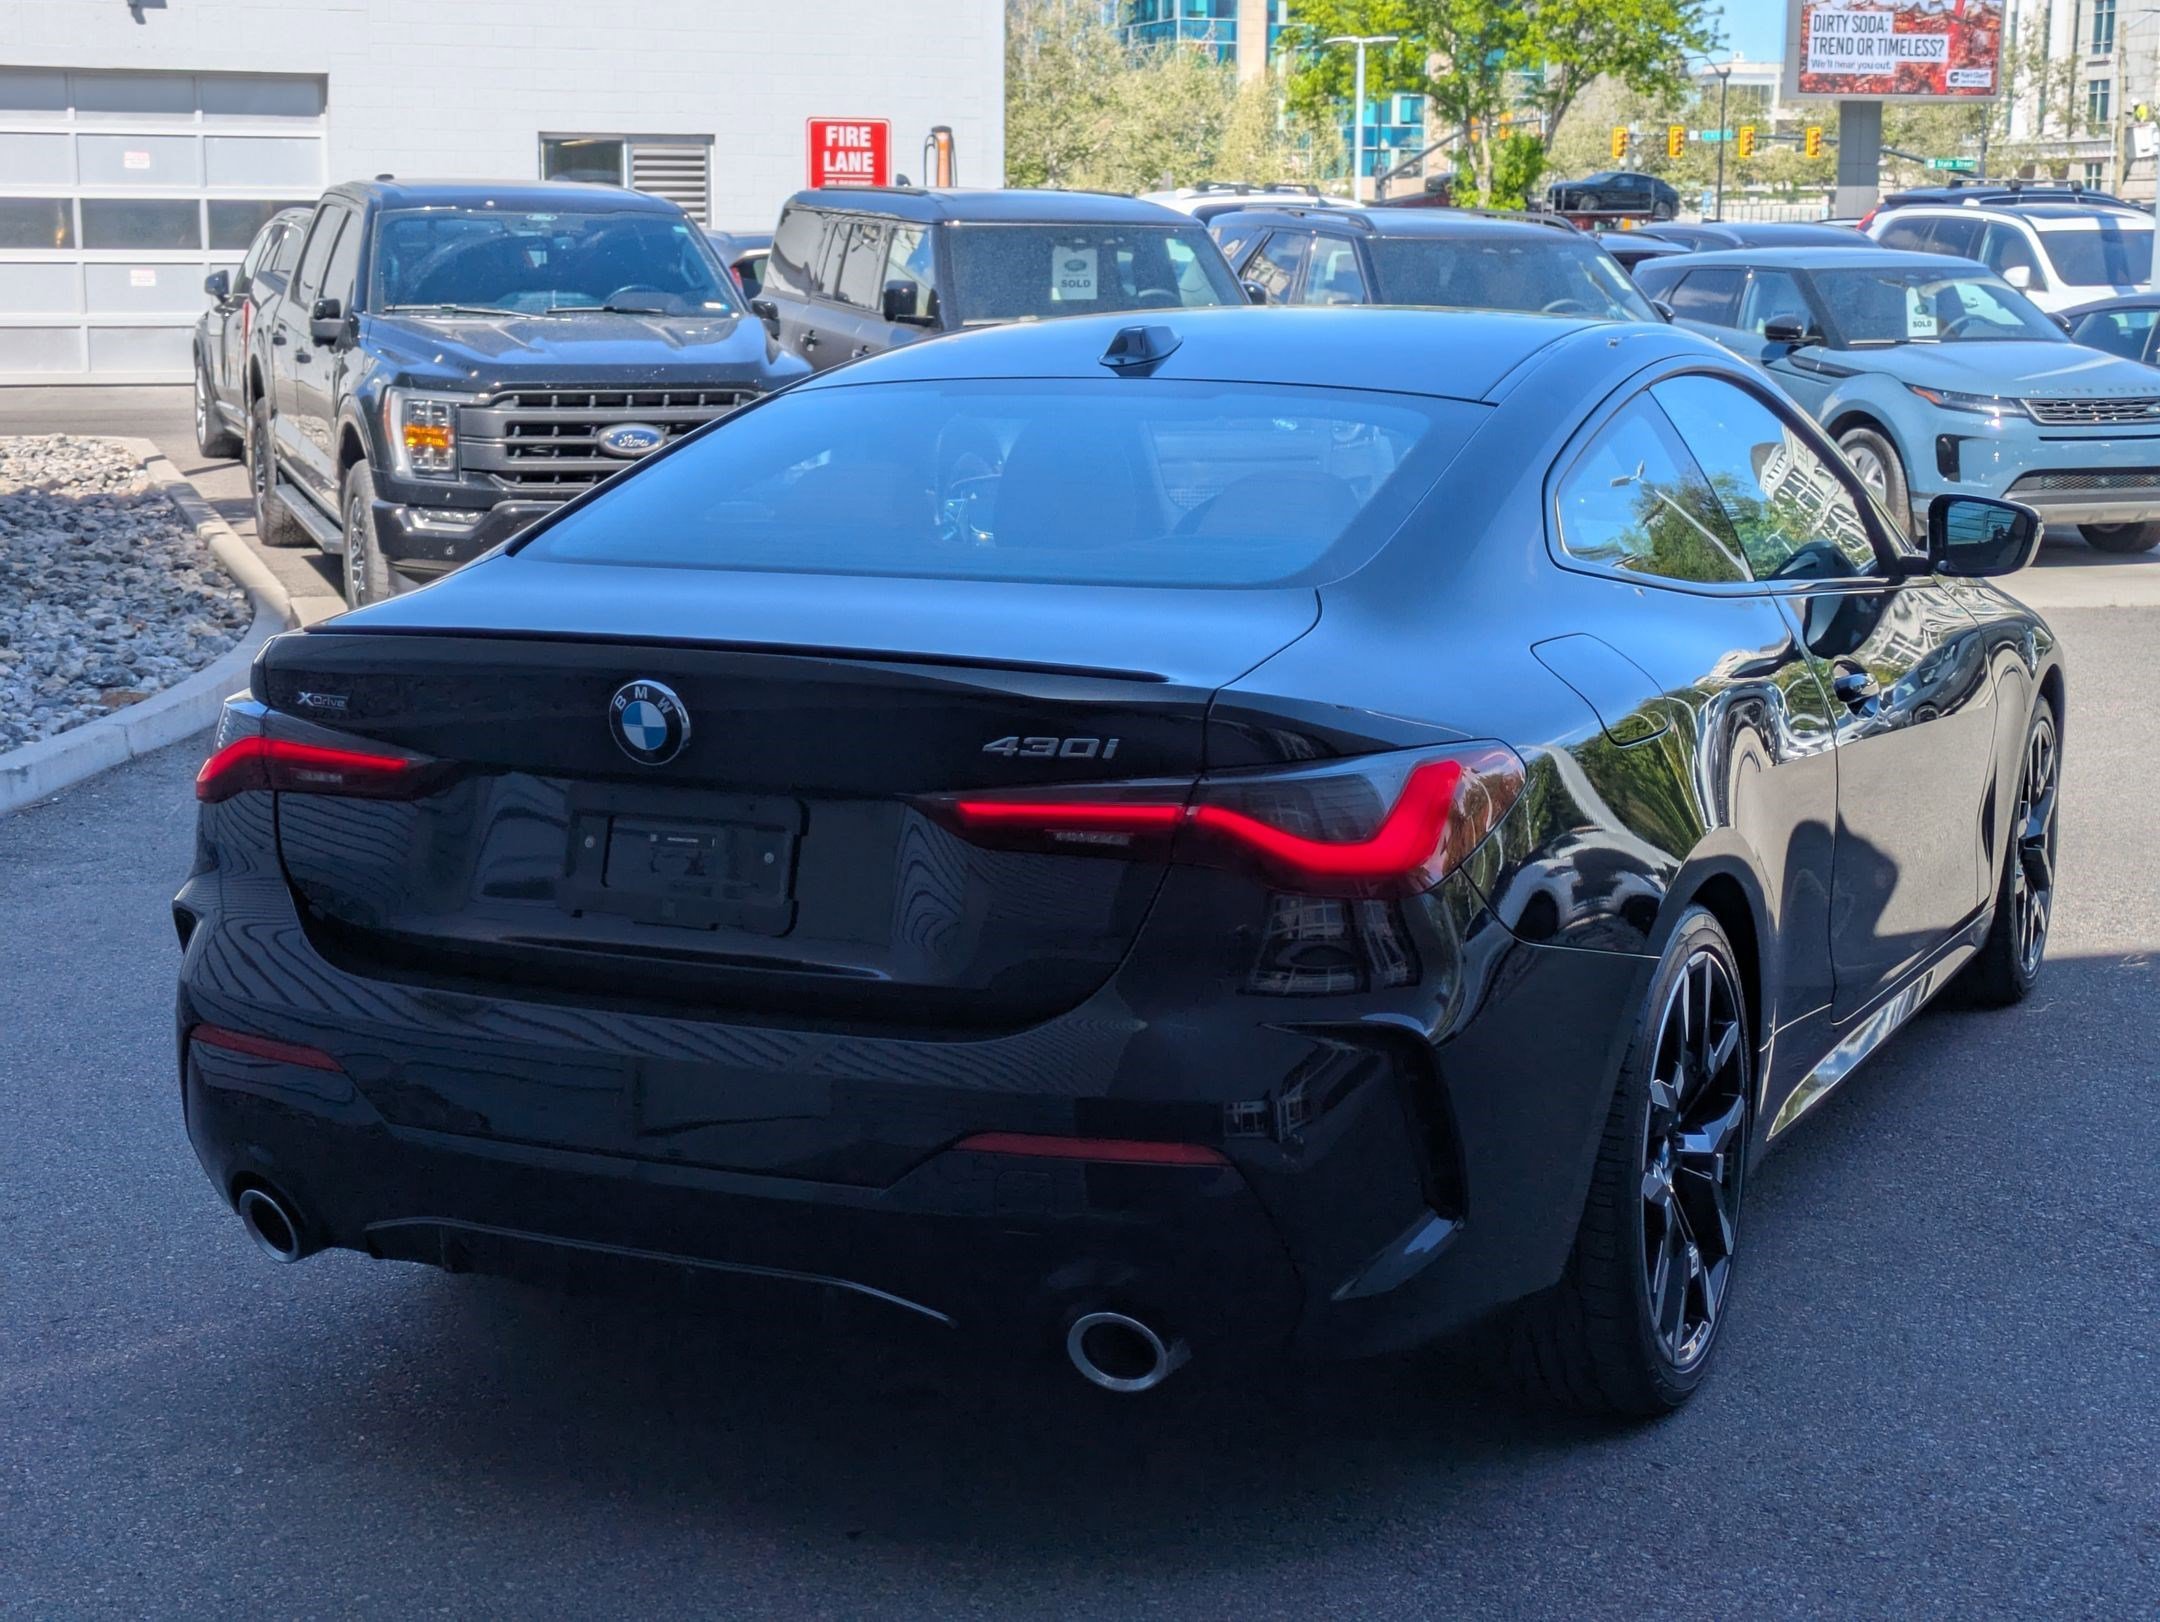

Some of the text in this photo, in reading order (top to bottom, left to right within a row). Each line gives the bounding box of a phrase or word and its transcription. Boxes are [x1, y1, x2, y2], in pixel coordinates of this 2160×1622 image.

[1813, 14, 1889, 34] DIRTY SODA:
[1812, 37, 1945, 57] TREND OR TIMELESS?
[1857, 61, 1873, 71] you
[825, 126, 871, 147] FIRE
[823, 151, 874, 172] LANE
[1061, 279, 1091, 288] SOLD
[1912, 320, 1932, 328] SOLD
[618, 434, 650, 447] Ford
[614, 686, 674, 714] BMW
[982, 736, 1120, 759] 430i
